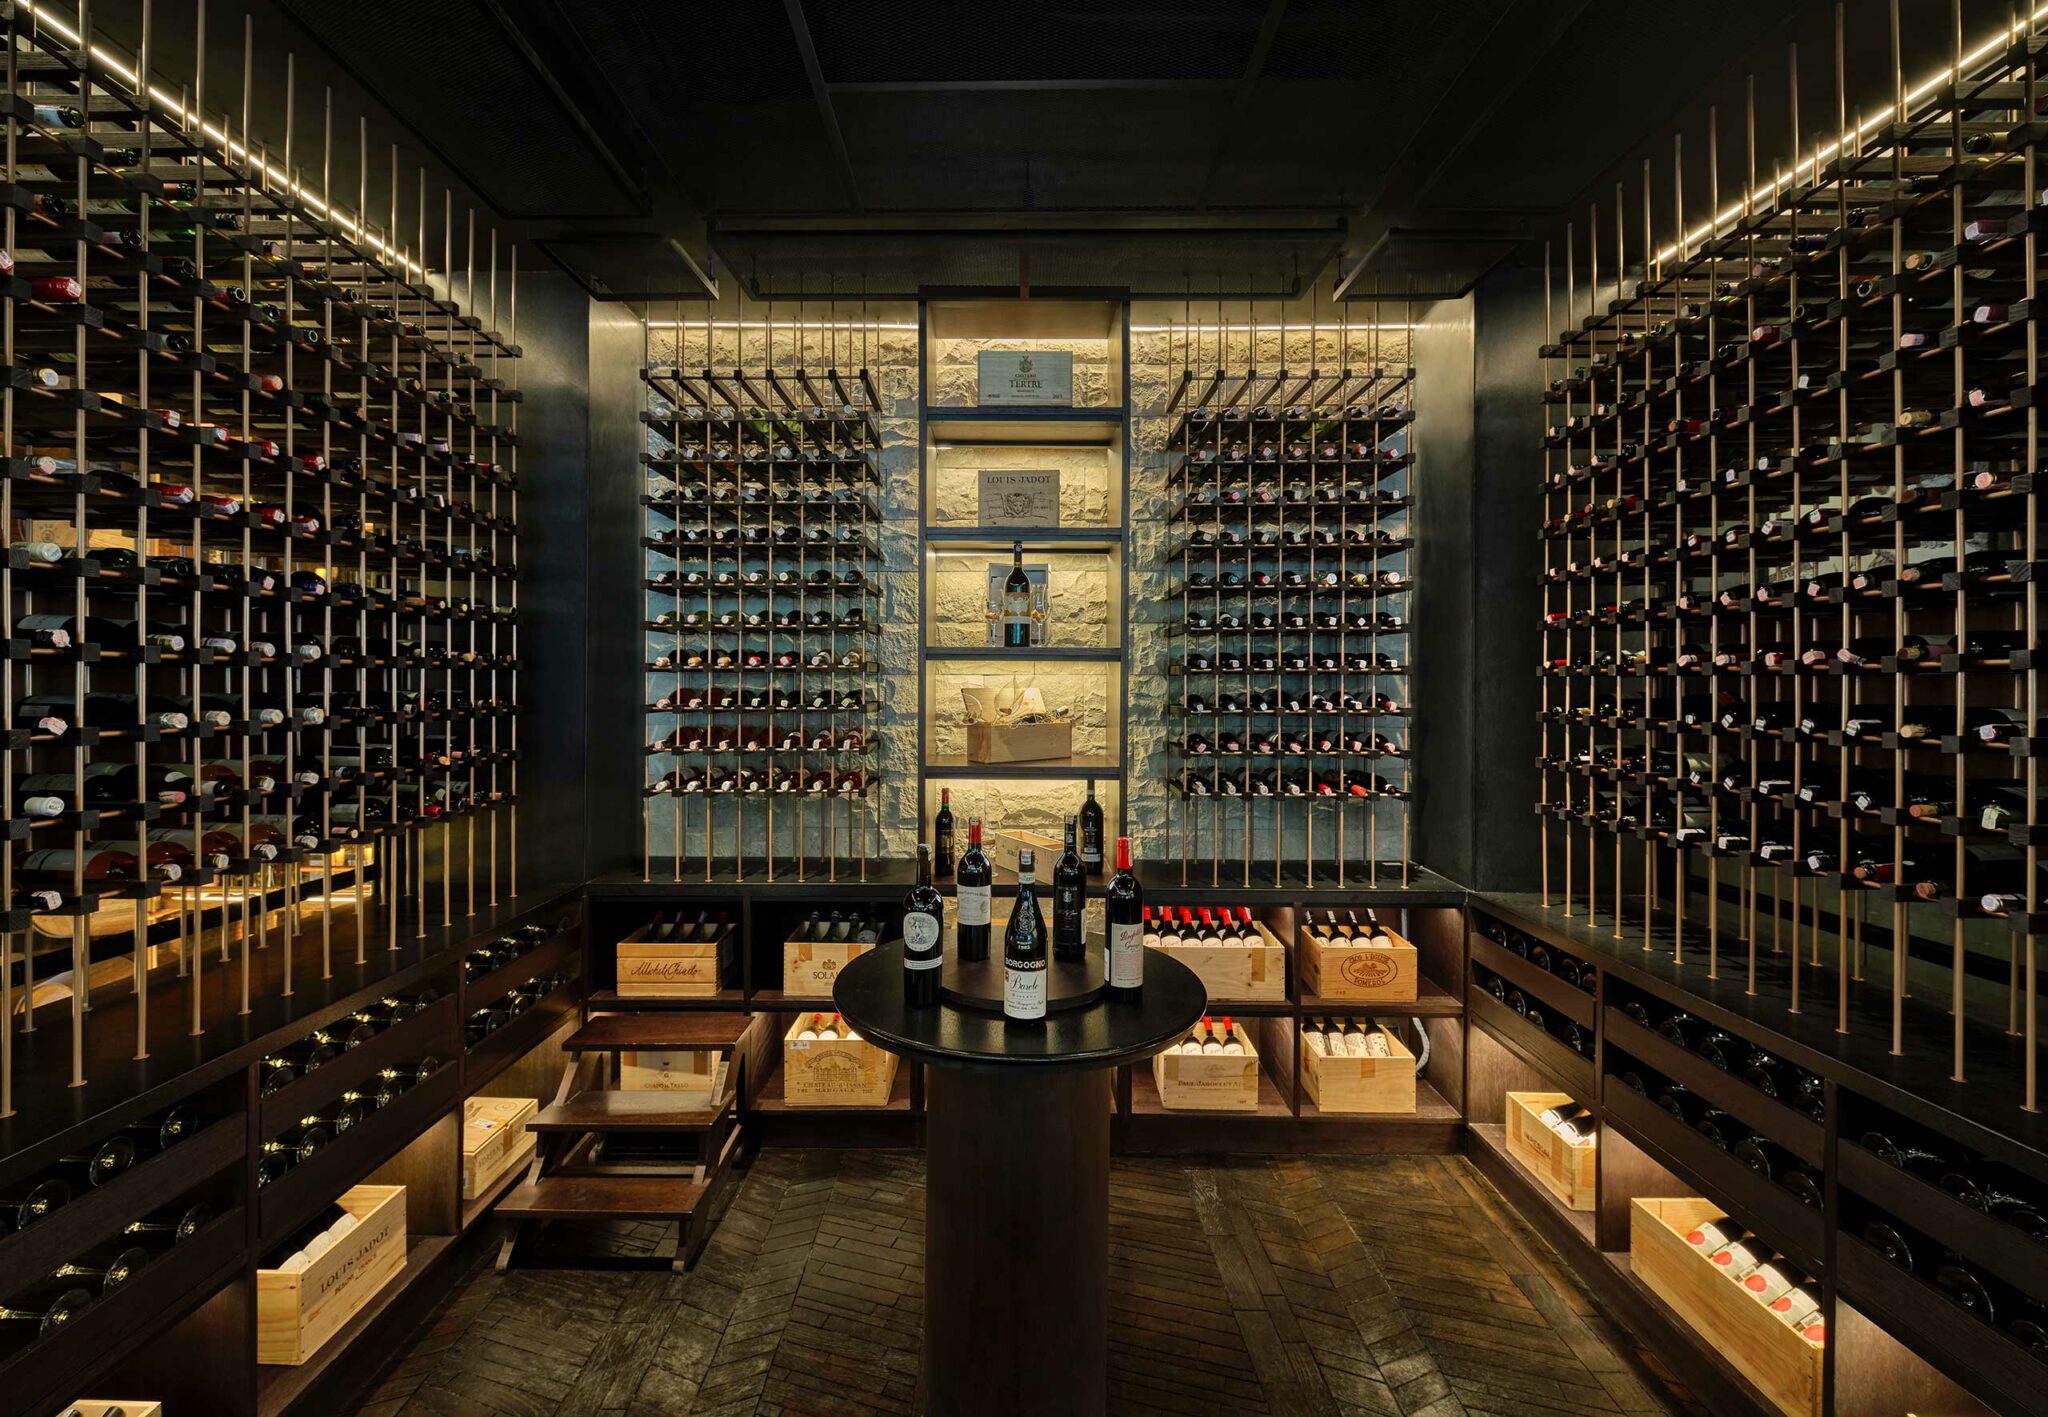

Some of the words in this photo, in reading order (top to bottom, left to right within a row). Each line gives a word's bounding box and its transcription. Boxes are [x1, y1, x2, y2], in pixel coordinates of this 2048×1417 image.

[1009, 379, 1043, 389] TERTRE
[987, 476, 1016, 484] LOUIS
[1018, 475, 1051, 484] JADOT
[1005, 957, 1046, 969] BORGOGNO
[320, 1258, 354, 1294] LOUIS
[356, 1226, 390, 1263] JADOT
